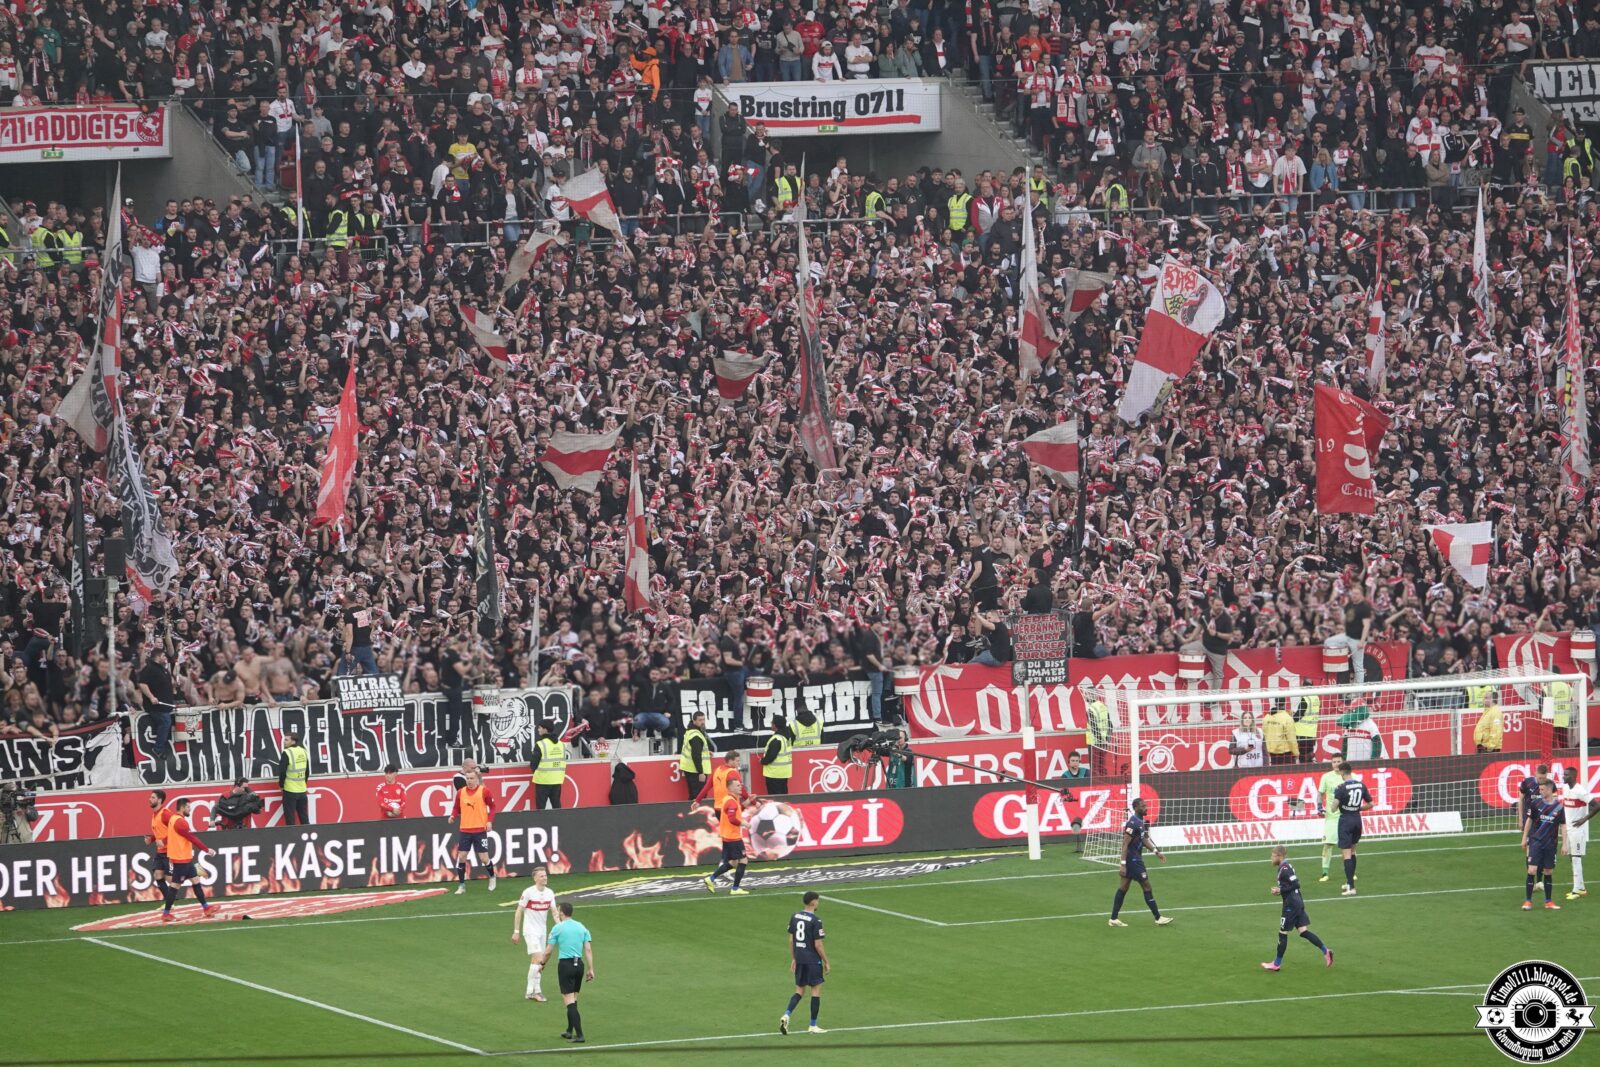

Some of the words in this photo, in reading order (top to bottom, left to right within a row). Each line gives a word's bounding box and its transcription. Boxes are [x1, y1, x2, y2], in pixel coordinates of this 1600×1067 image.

[740, 95, 847, 122] Brustring
[854, 89, 904, 116] 0711
[34, 113, 128, 142] ADDICTS
[1027, 668, 1066, 676] IMMER
[1044, 660, 1065, 668] BIST
[338, 675, 400, 692] ULTRAS
[340, 688, 402, 701] BEDEUTET
[342, 698, 405, 710] WIDERSTAND
[1503, 712, 1523, 733] 35
[1348, 789, 1362, 806] 10
[1183, 823, 1276, 845] WINAMAX
[275, 832, 366, 881] KÄSE
[380, 834, 417, 873] IM
[796, 920, 806, 941] 8
